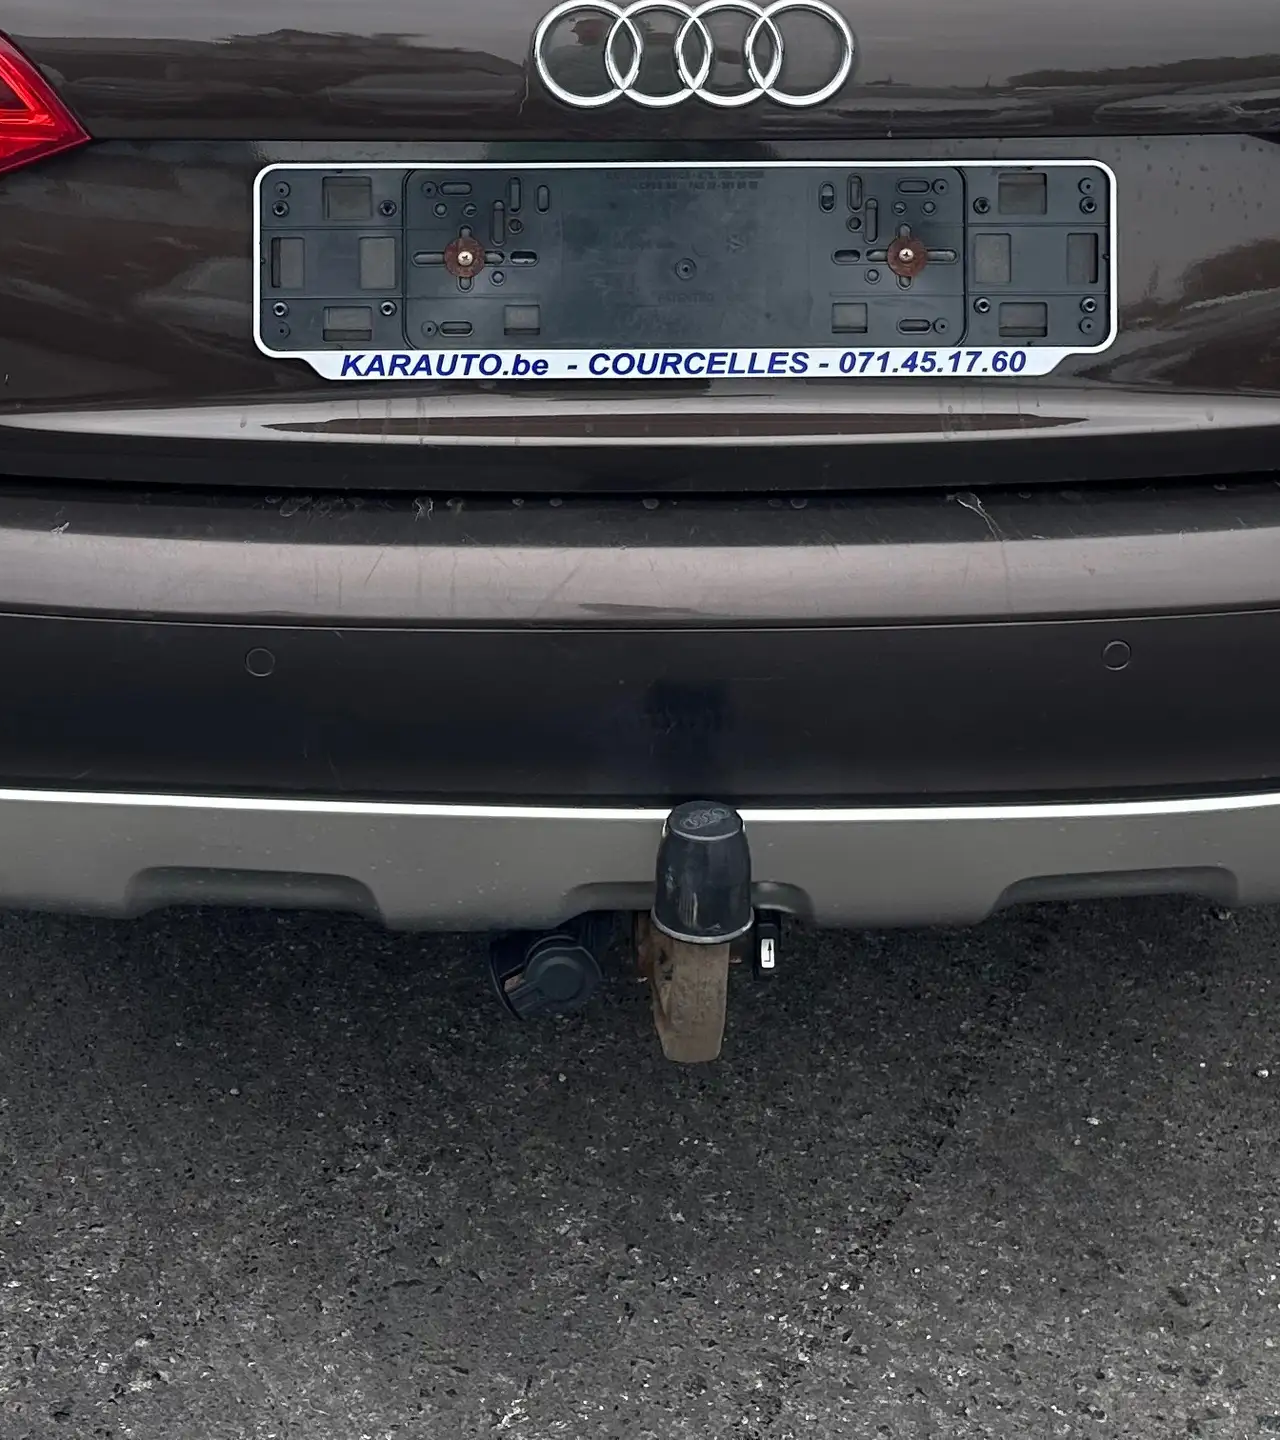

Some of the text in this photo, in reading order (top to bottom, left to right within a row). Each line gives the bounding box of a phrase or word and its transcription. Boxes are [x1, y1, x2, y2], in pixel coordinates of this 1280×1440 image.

[340, 354, 549, 377] KARAUTO.be
[588, 351, 810, 376] COURCELLES
[839, 349, 1027, 375] 071.45.17.60
